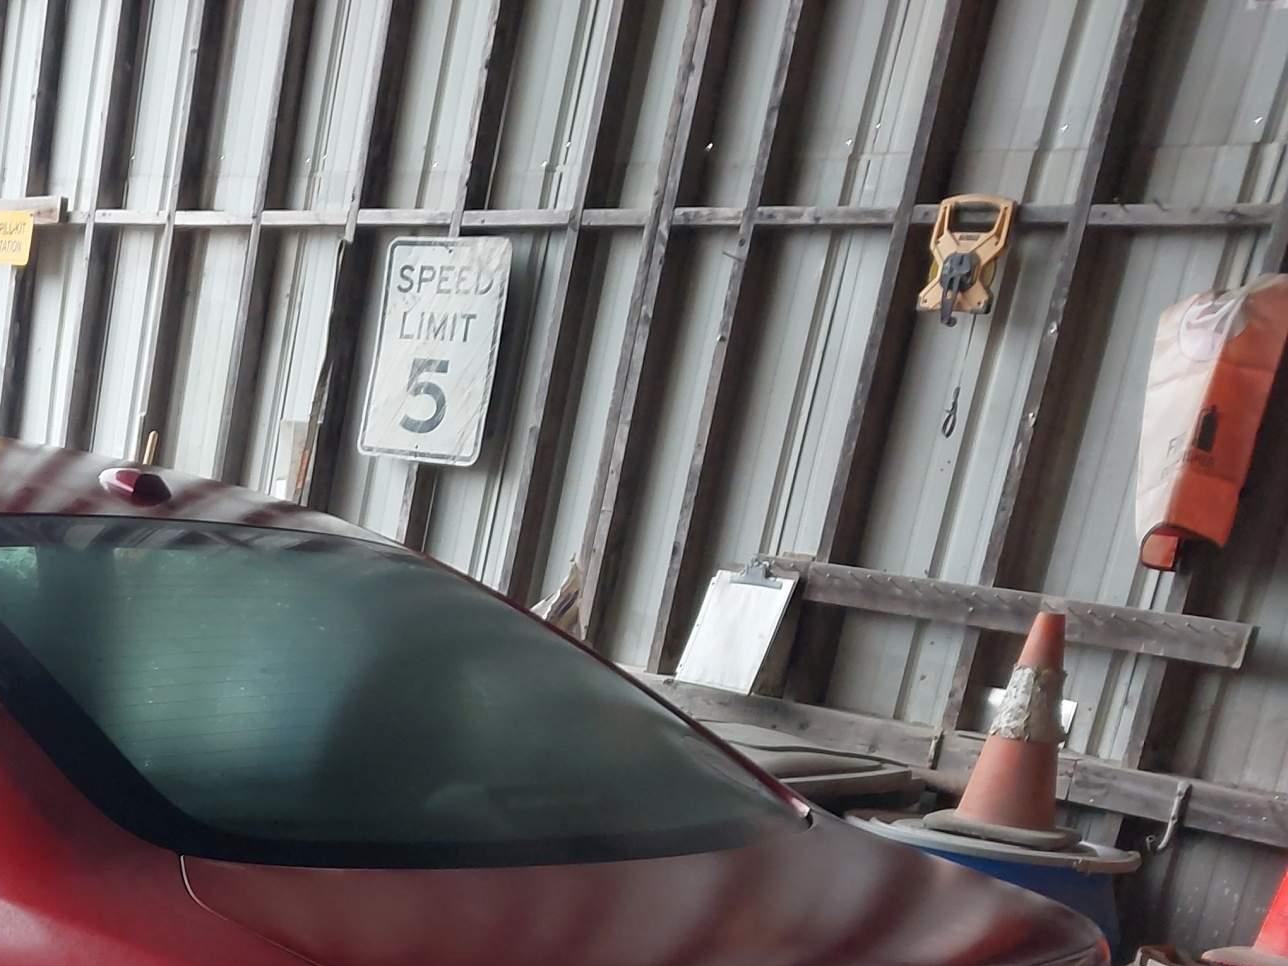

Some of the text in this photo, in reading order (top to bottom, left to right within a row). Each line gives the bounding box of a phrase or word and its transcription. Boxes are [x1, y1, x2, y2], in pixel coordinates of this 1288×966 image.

[397, 264, 494, 296] SPEED
[399, 311, 477, 343] LIMIT
[399, 357, 450, 434] 5
